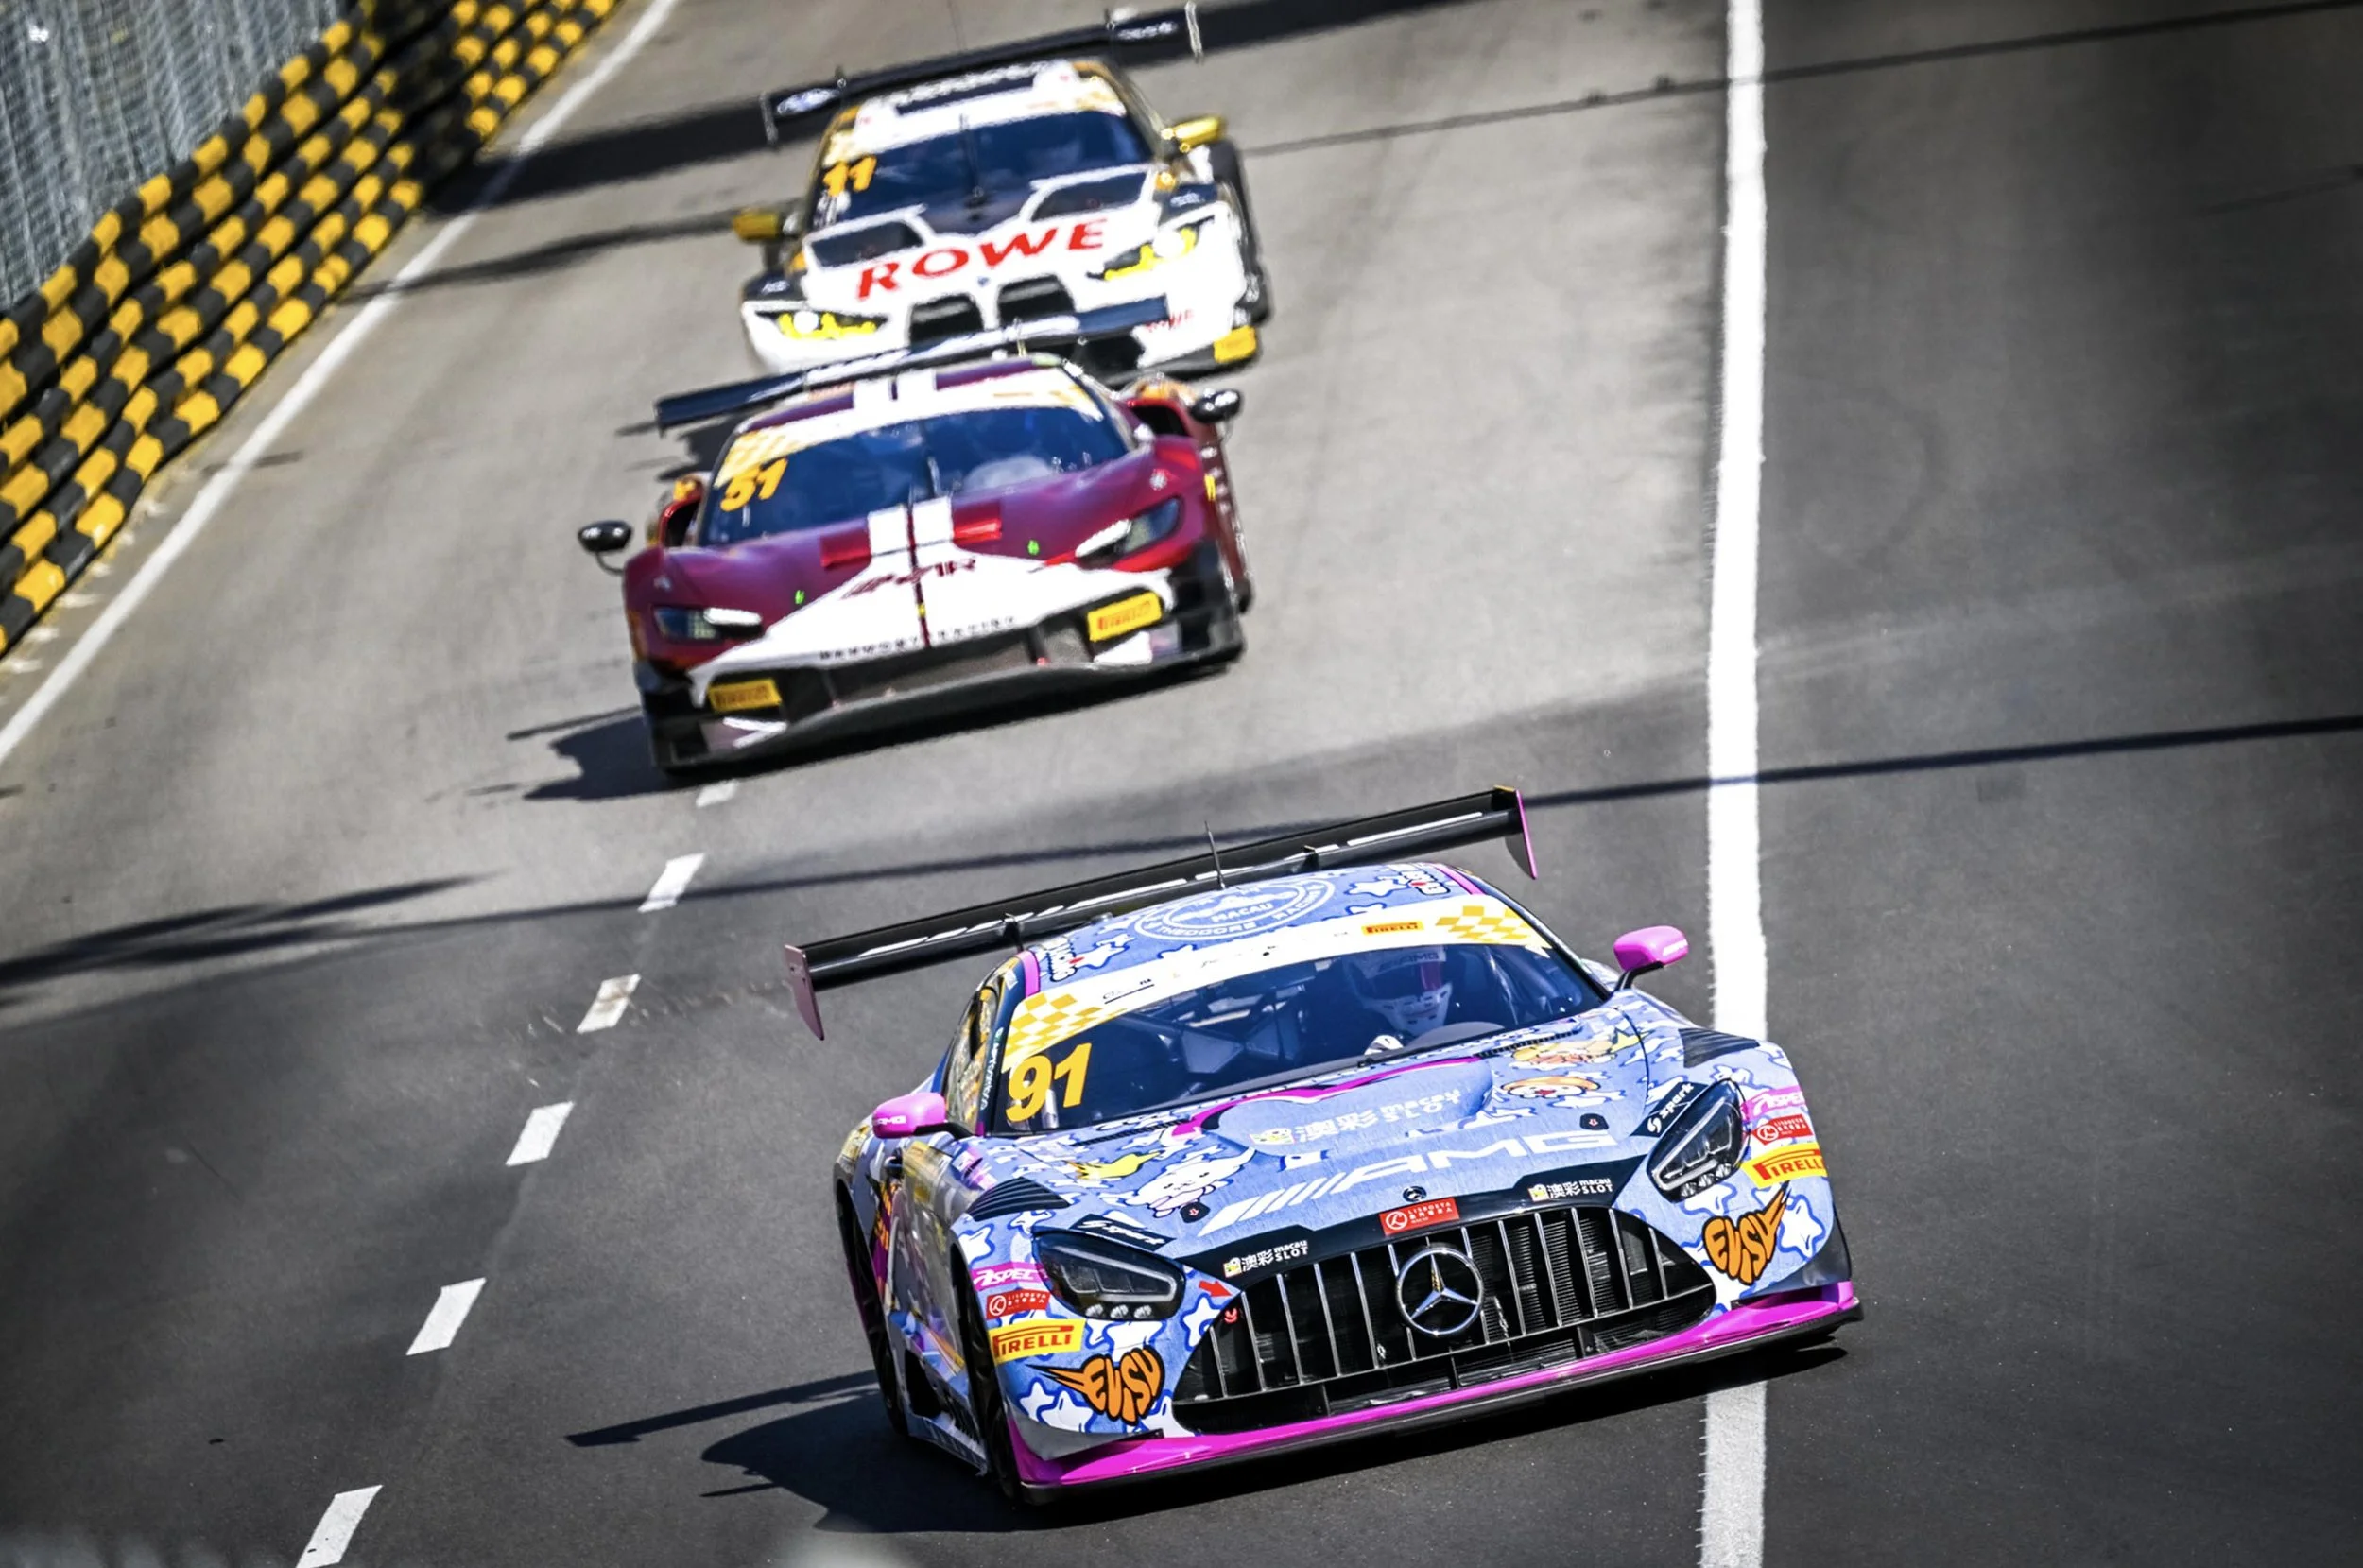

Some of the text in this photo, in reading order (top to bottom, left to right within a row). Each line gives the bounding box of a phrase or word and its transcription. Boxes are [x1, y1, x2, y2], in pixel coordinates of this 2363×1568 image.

[823, 154, 877, 197] 11
[856, 218, 1109, 301] ROWE
[720, 457, 788, 511] 51
[1211, 903, 1273, 922] MACAU
[1159, 921, 1257, 936] THEODORE
[1366, 922, 1418, 934] PIRELLI
[1005, 1042, 1093, 1123] 91
[1659, 1082, 1695, 1120] spark
[1294, 1109, 1379, 1143] 澳彩
[1333, 1129, 1617, 1194] AMG
[1547, 1183, 1581, 1199] 澳彩
[1579, 1178, 1611, 1187] macau
[1582, 1184, 1613, 1196] SLOT
[1408, 1201, 1451, 1215] LISBOETA
[1274, 1240, 1308, 1253] macau
[1703, 1195, 1785, 1284] EVISU
[1240, 1251, 1274, 1273] 澳彩
[1275, 1246, 1309, 1261] SLOT
[992, 1325, 1074, 1358] PIRELLI
[1051, 1347, 1164, 1423] EVISU
